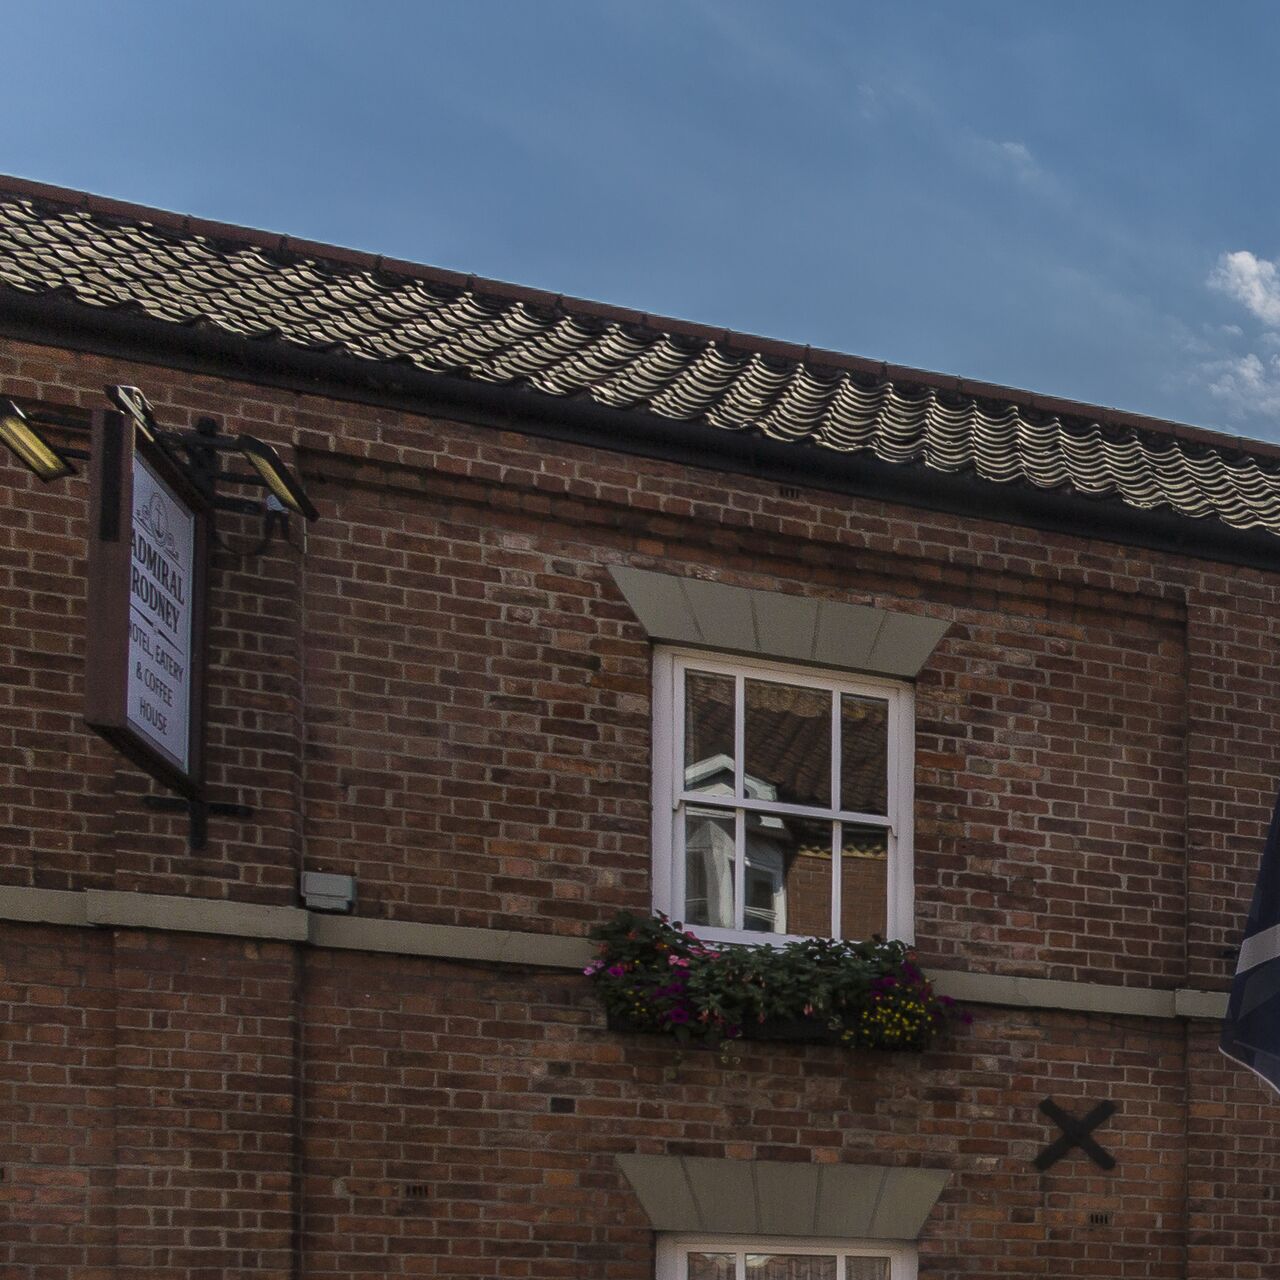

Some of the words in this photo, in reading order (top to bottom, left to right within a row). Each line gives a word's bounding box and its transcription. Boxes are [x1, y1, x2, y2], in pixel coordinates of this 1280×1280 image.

[130, 528, 184, 605] ADMIRAL
[132, 564, 180, 634] RODNEY
[136, 661, 143, 681] &
[144, 668, 173, 708] COFFEE
[155, 645, 184, 684] EATERY
[139, 697, 168, 736] HOUSE
